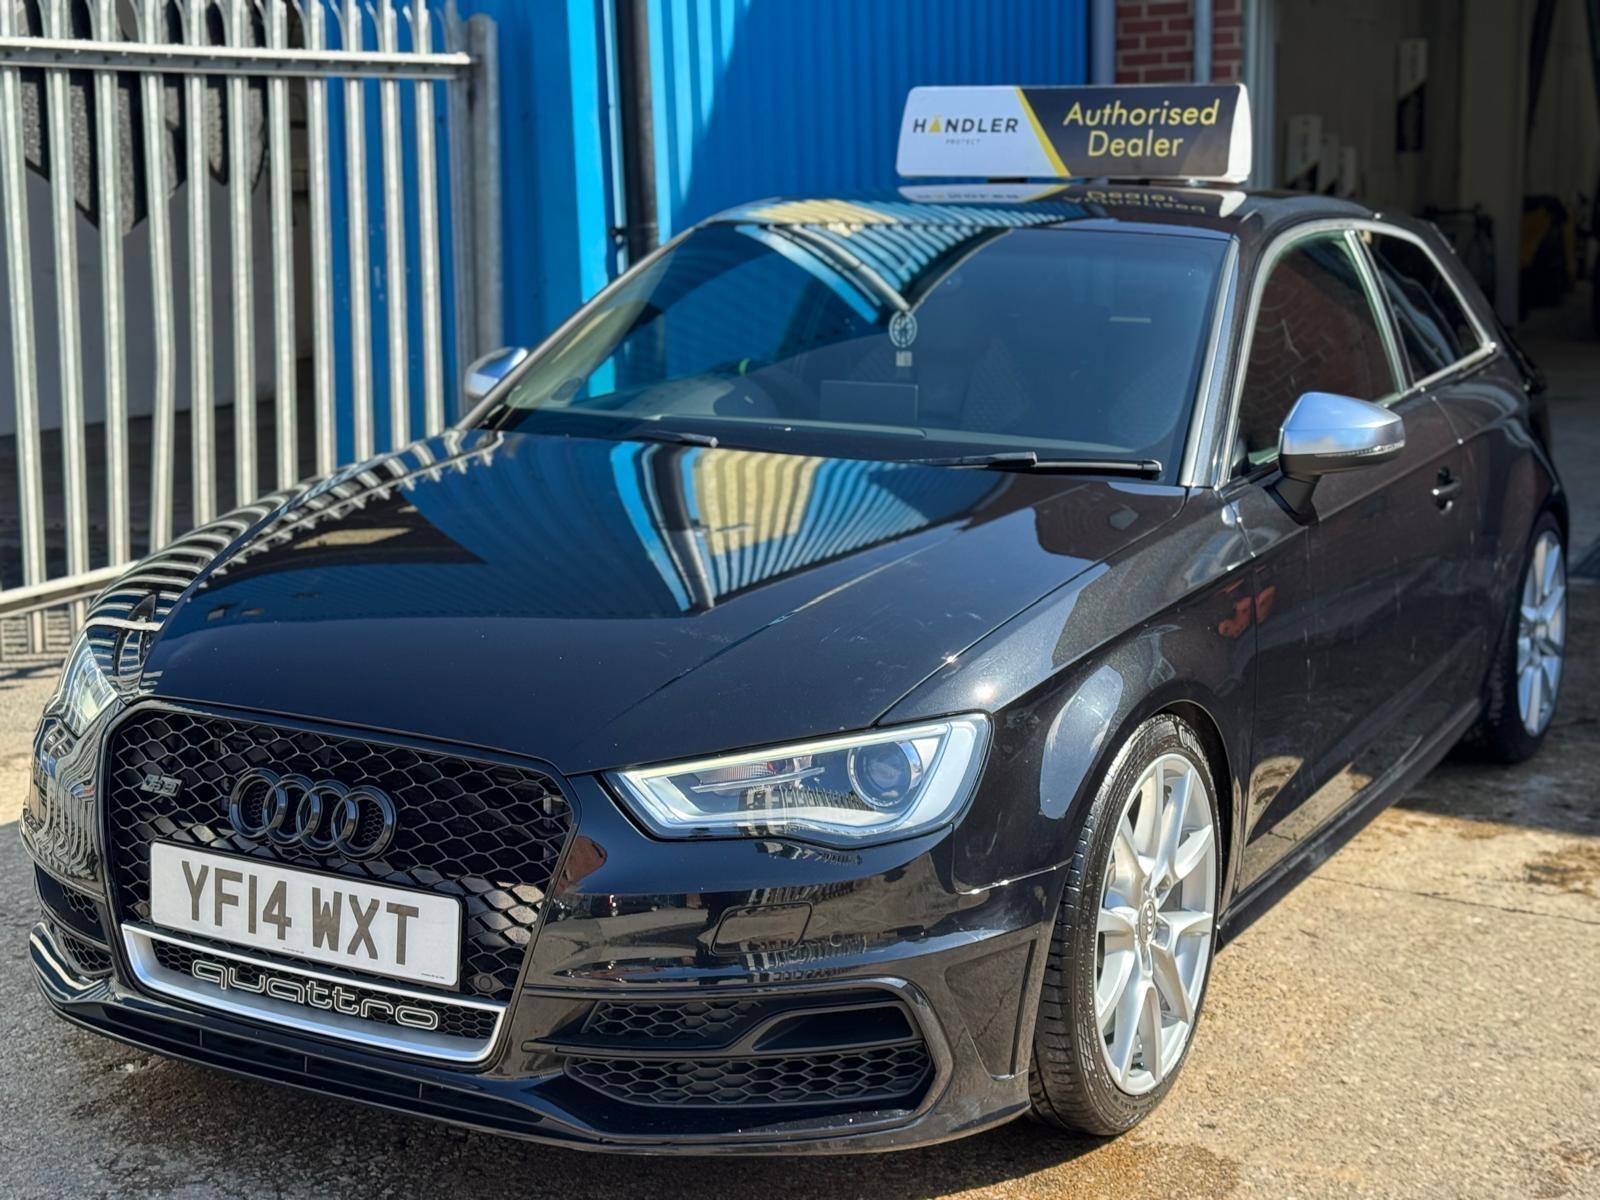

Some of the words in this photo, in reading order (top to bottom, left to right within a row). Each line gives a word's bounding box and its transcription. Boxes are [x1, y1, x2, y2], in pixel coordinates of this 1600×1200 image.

[1063, 98, 1221, 127] Authorised
[1087, 128, 1184, 158] Dealer
[181, 860, 292, 941] YF14
[311, 886, 420, 966] WXT
[191, 959, 440, 1031] quattro
